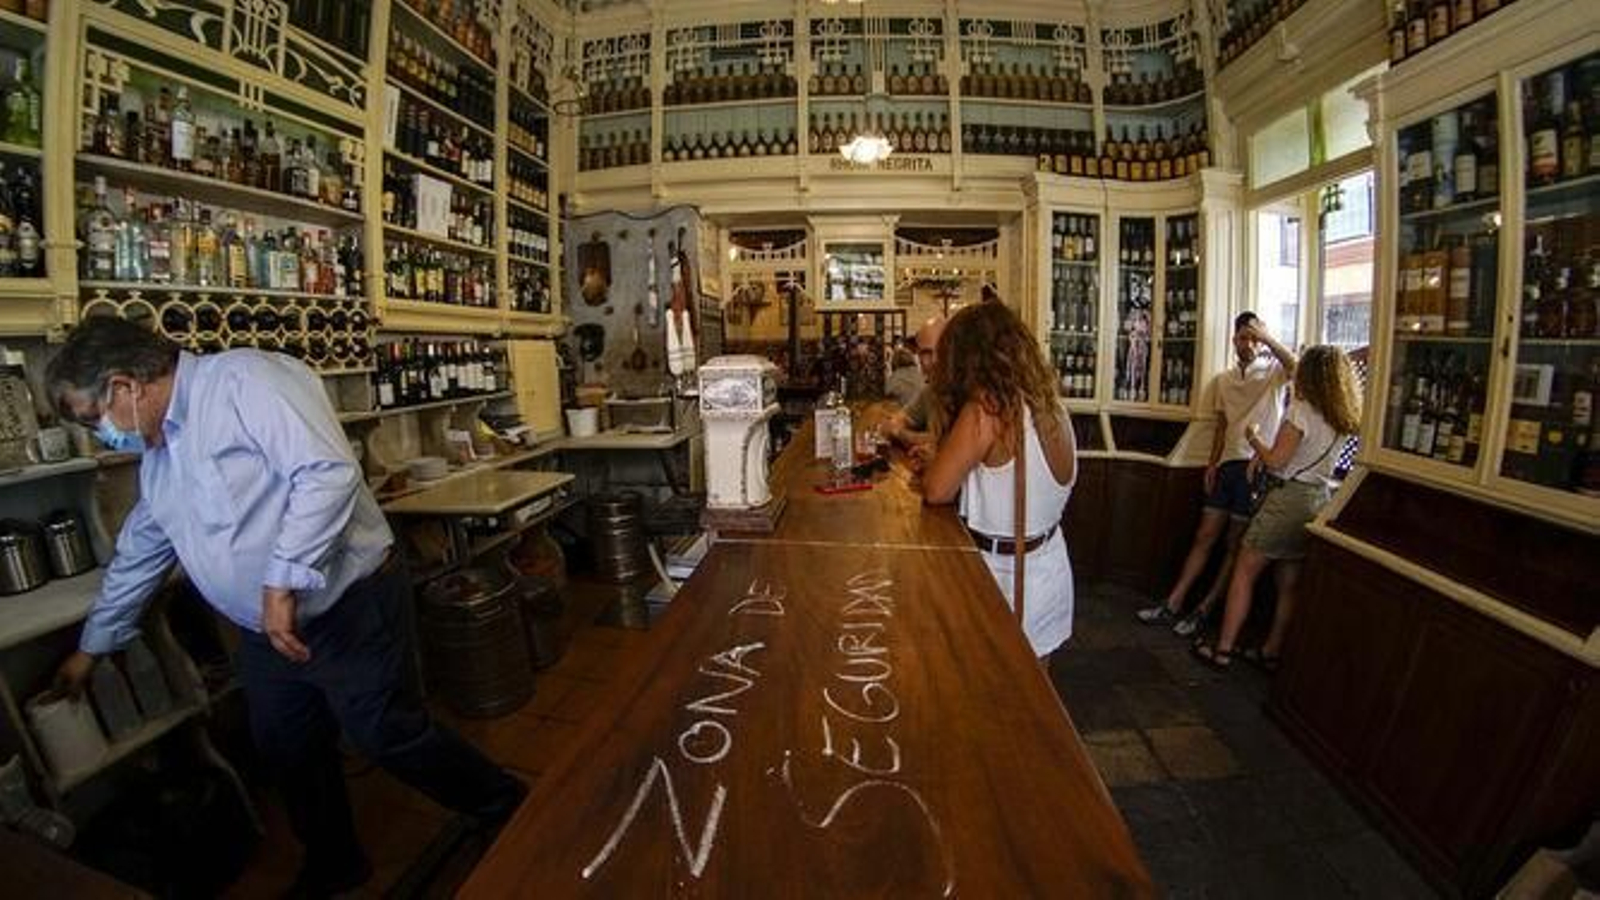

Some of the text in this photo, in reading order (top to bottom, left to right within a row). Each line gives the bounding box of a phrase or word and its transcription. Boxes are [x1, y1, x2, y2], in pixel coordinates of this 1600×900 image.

[876, 156, 933, 172] NEGRITA
[582, 577, 787, 879] ZONA DE
[784, 569, 953, 897] SEGURIDAD
